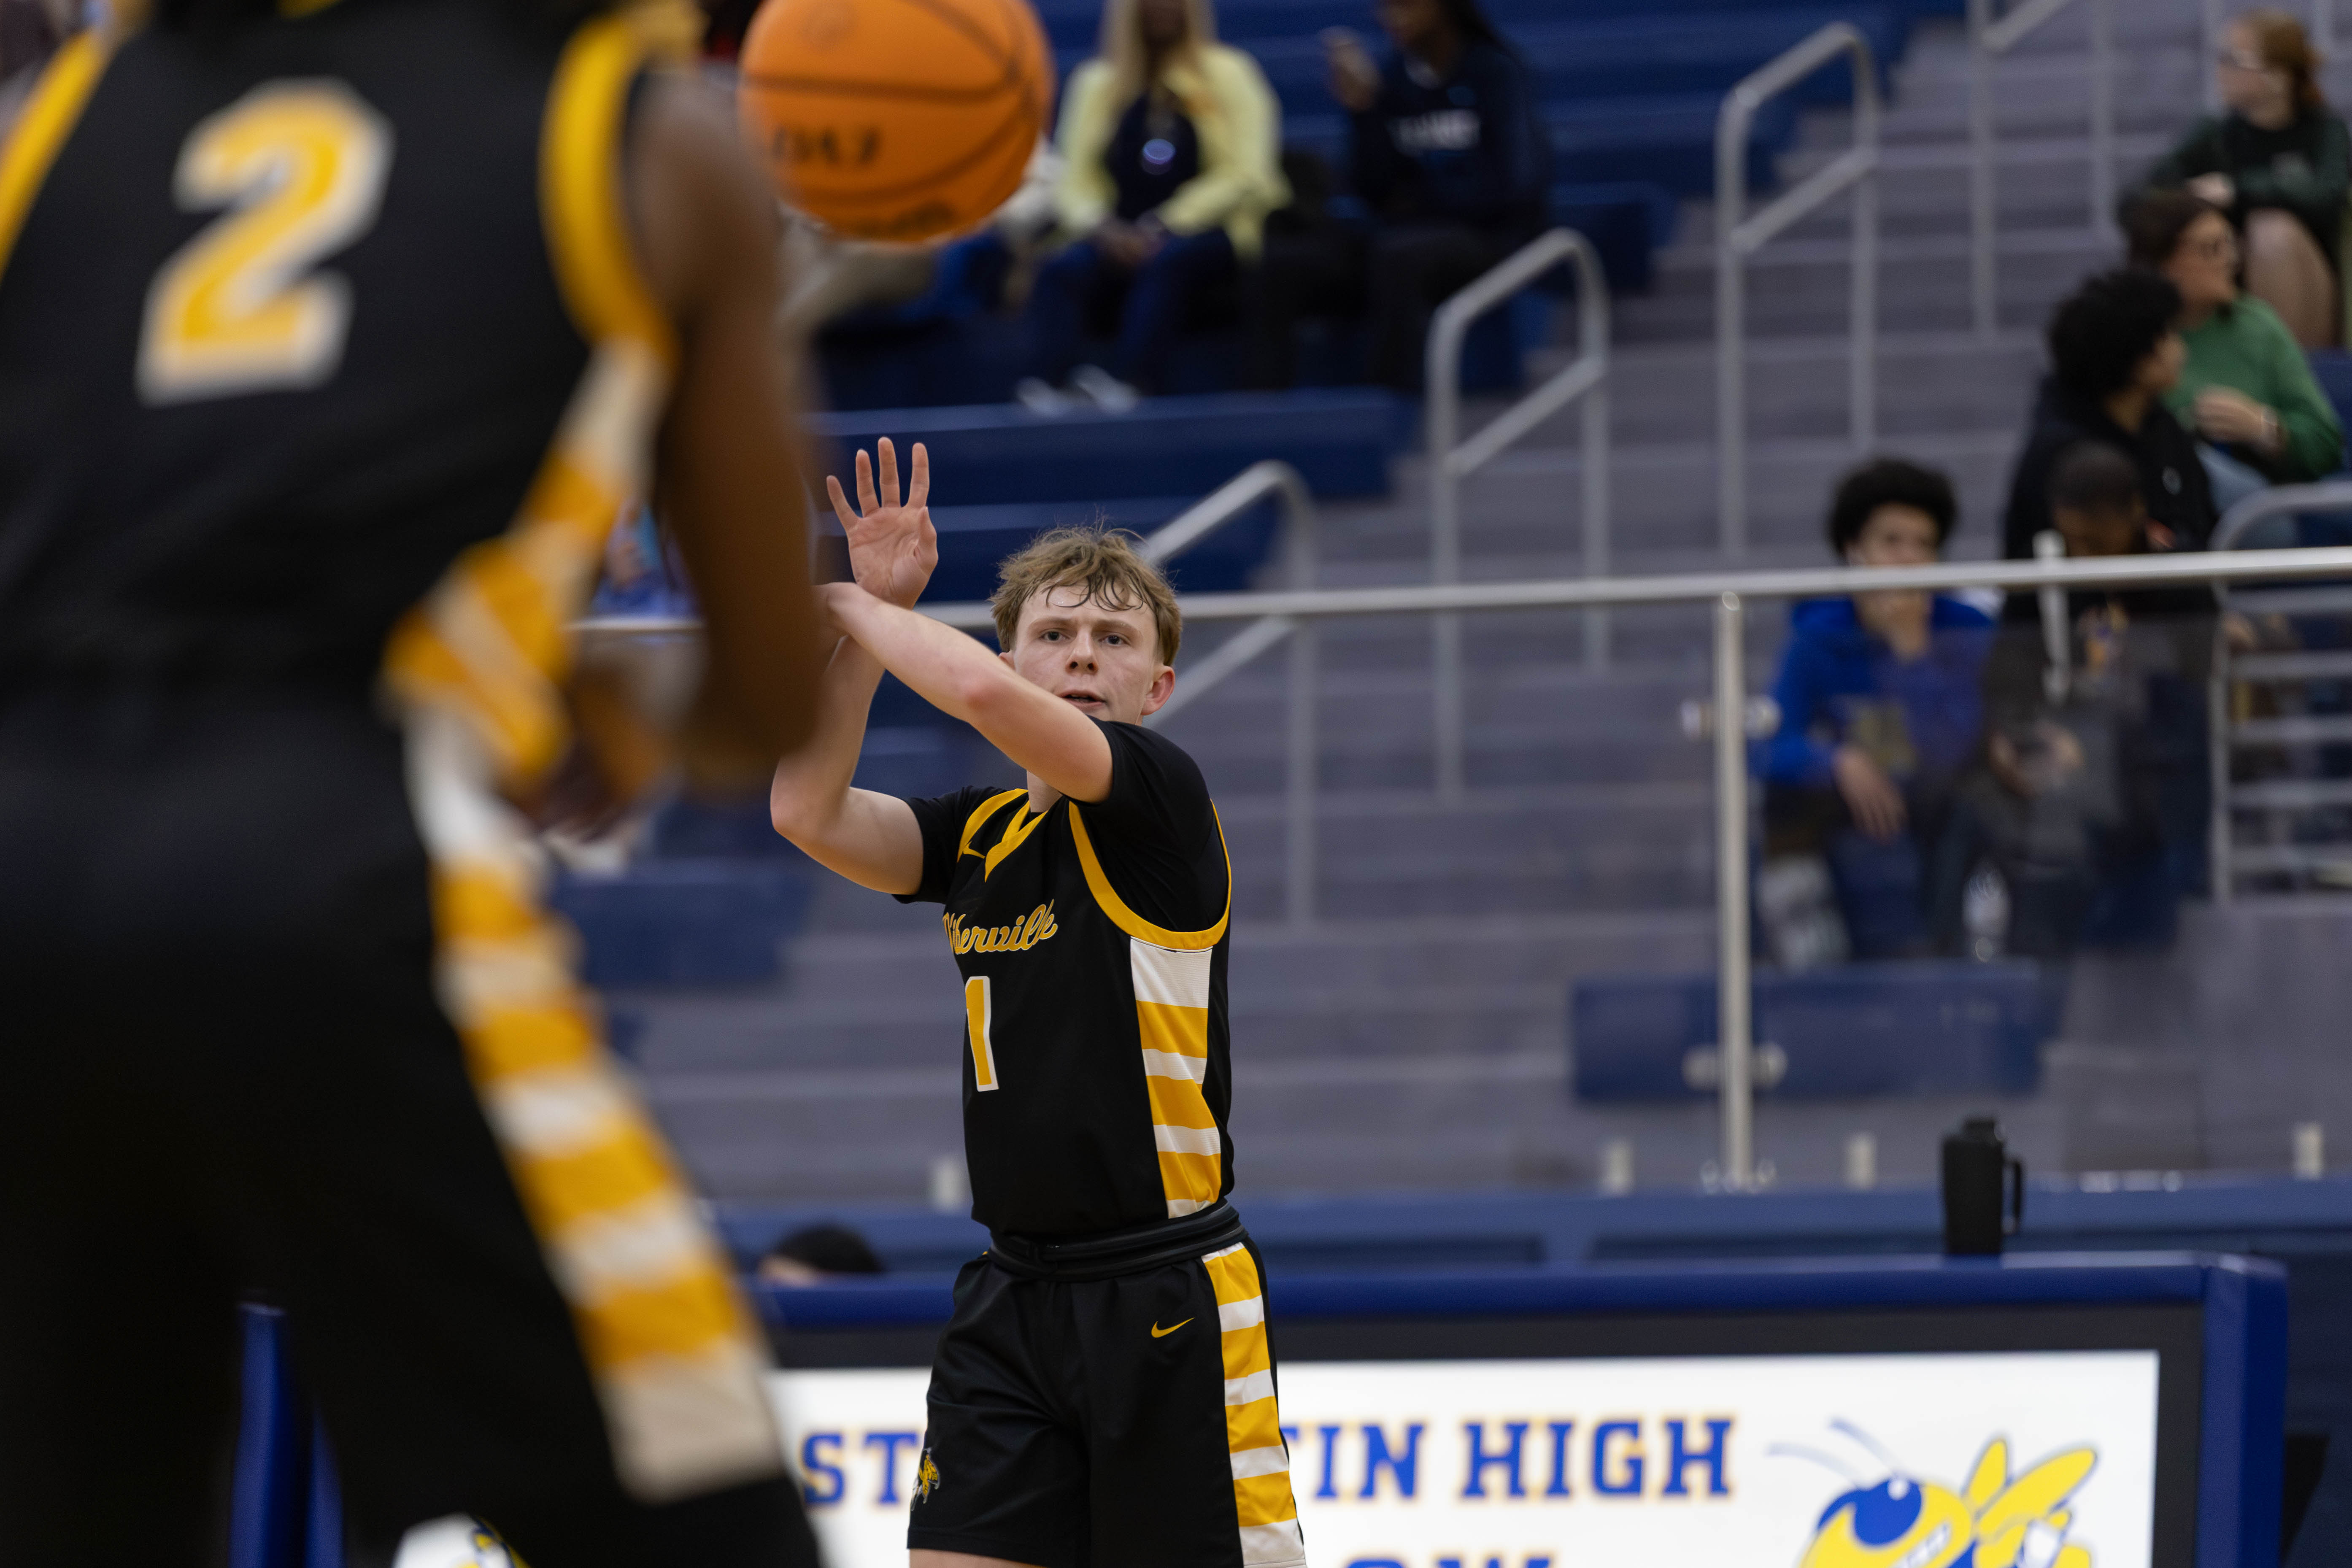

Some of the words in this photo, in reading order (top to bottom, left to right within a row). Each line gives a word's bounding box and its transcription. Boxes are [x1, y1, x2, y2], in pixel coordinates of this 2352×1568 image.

[137, 77, 393, 404] 2
[965, 976, 999, 1092] 1
[1460, 1418, 1733, 1499] HIGH
